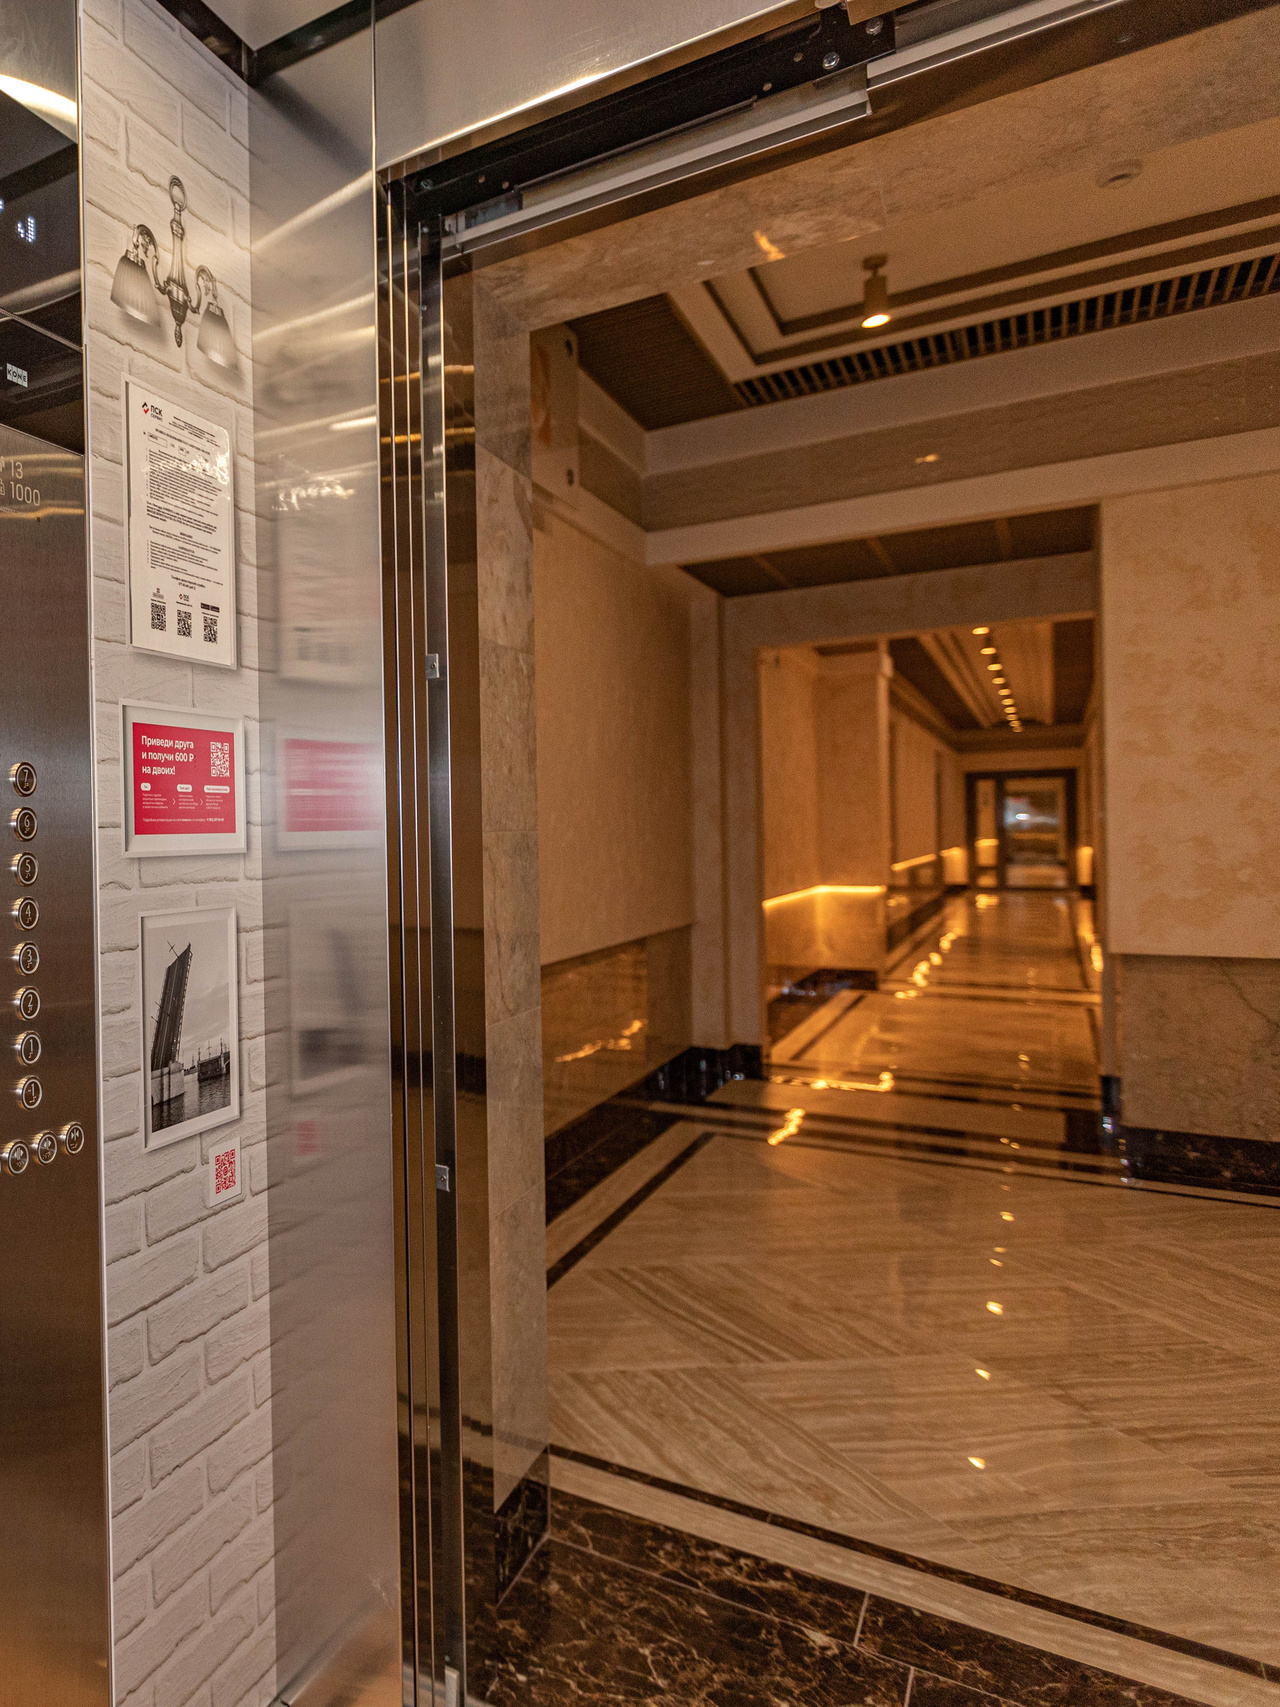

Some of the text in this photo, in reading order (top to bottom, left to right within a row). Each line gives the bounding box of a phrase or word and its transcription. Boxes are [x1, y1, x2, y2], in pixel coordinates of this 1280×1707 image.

[7, 369, 27, 383] KONE
[10, 459, 23, 479] 13
[10, 481, 40, 506] 1000
[141, 735, 194, 750] Приведи друга
[148, 752, 174, 763] получи
[175, 752, 188, 762] 600
[142, 766, 176, 775] на двоих!
